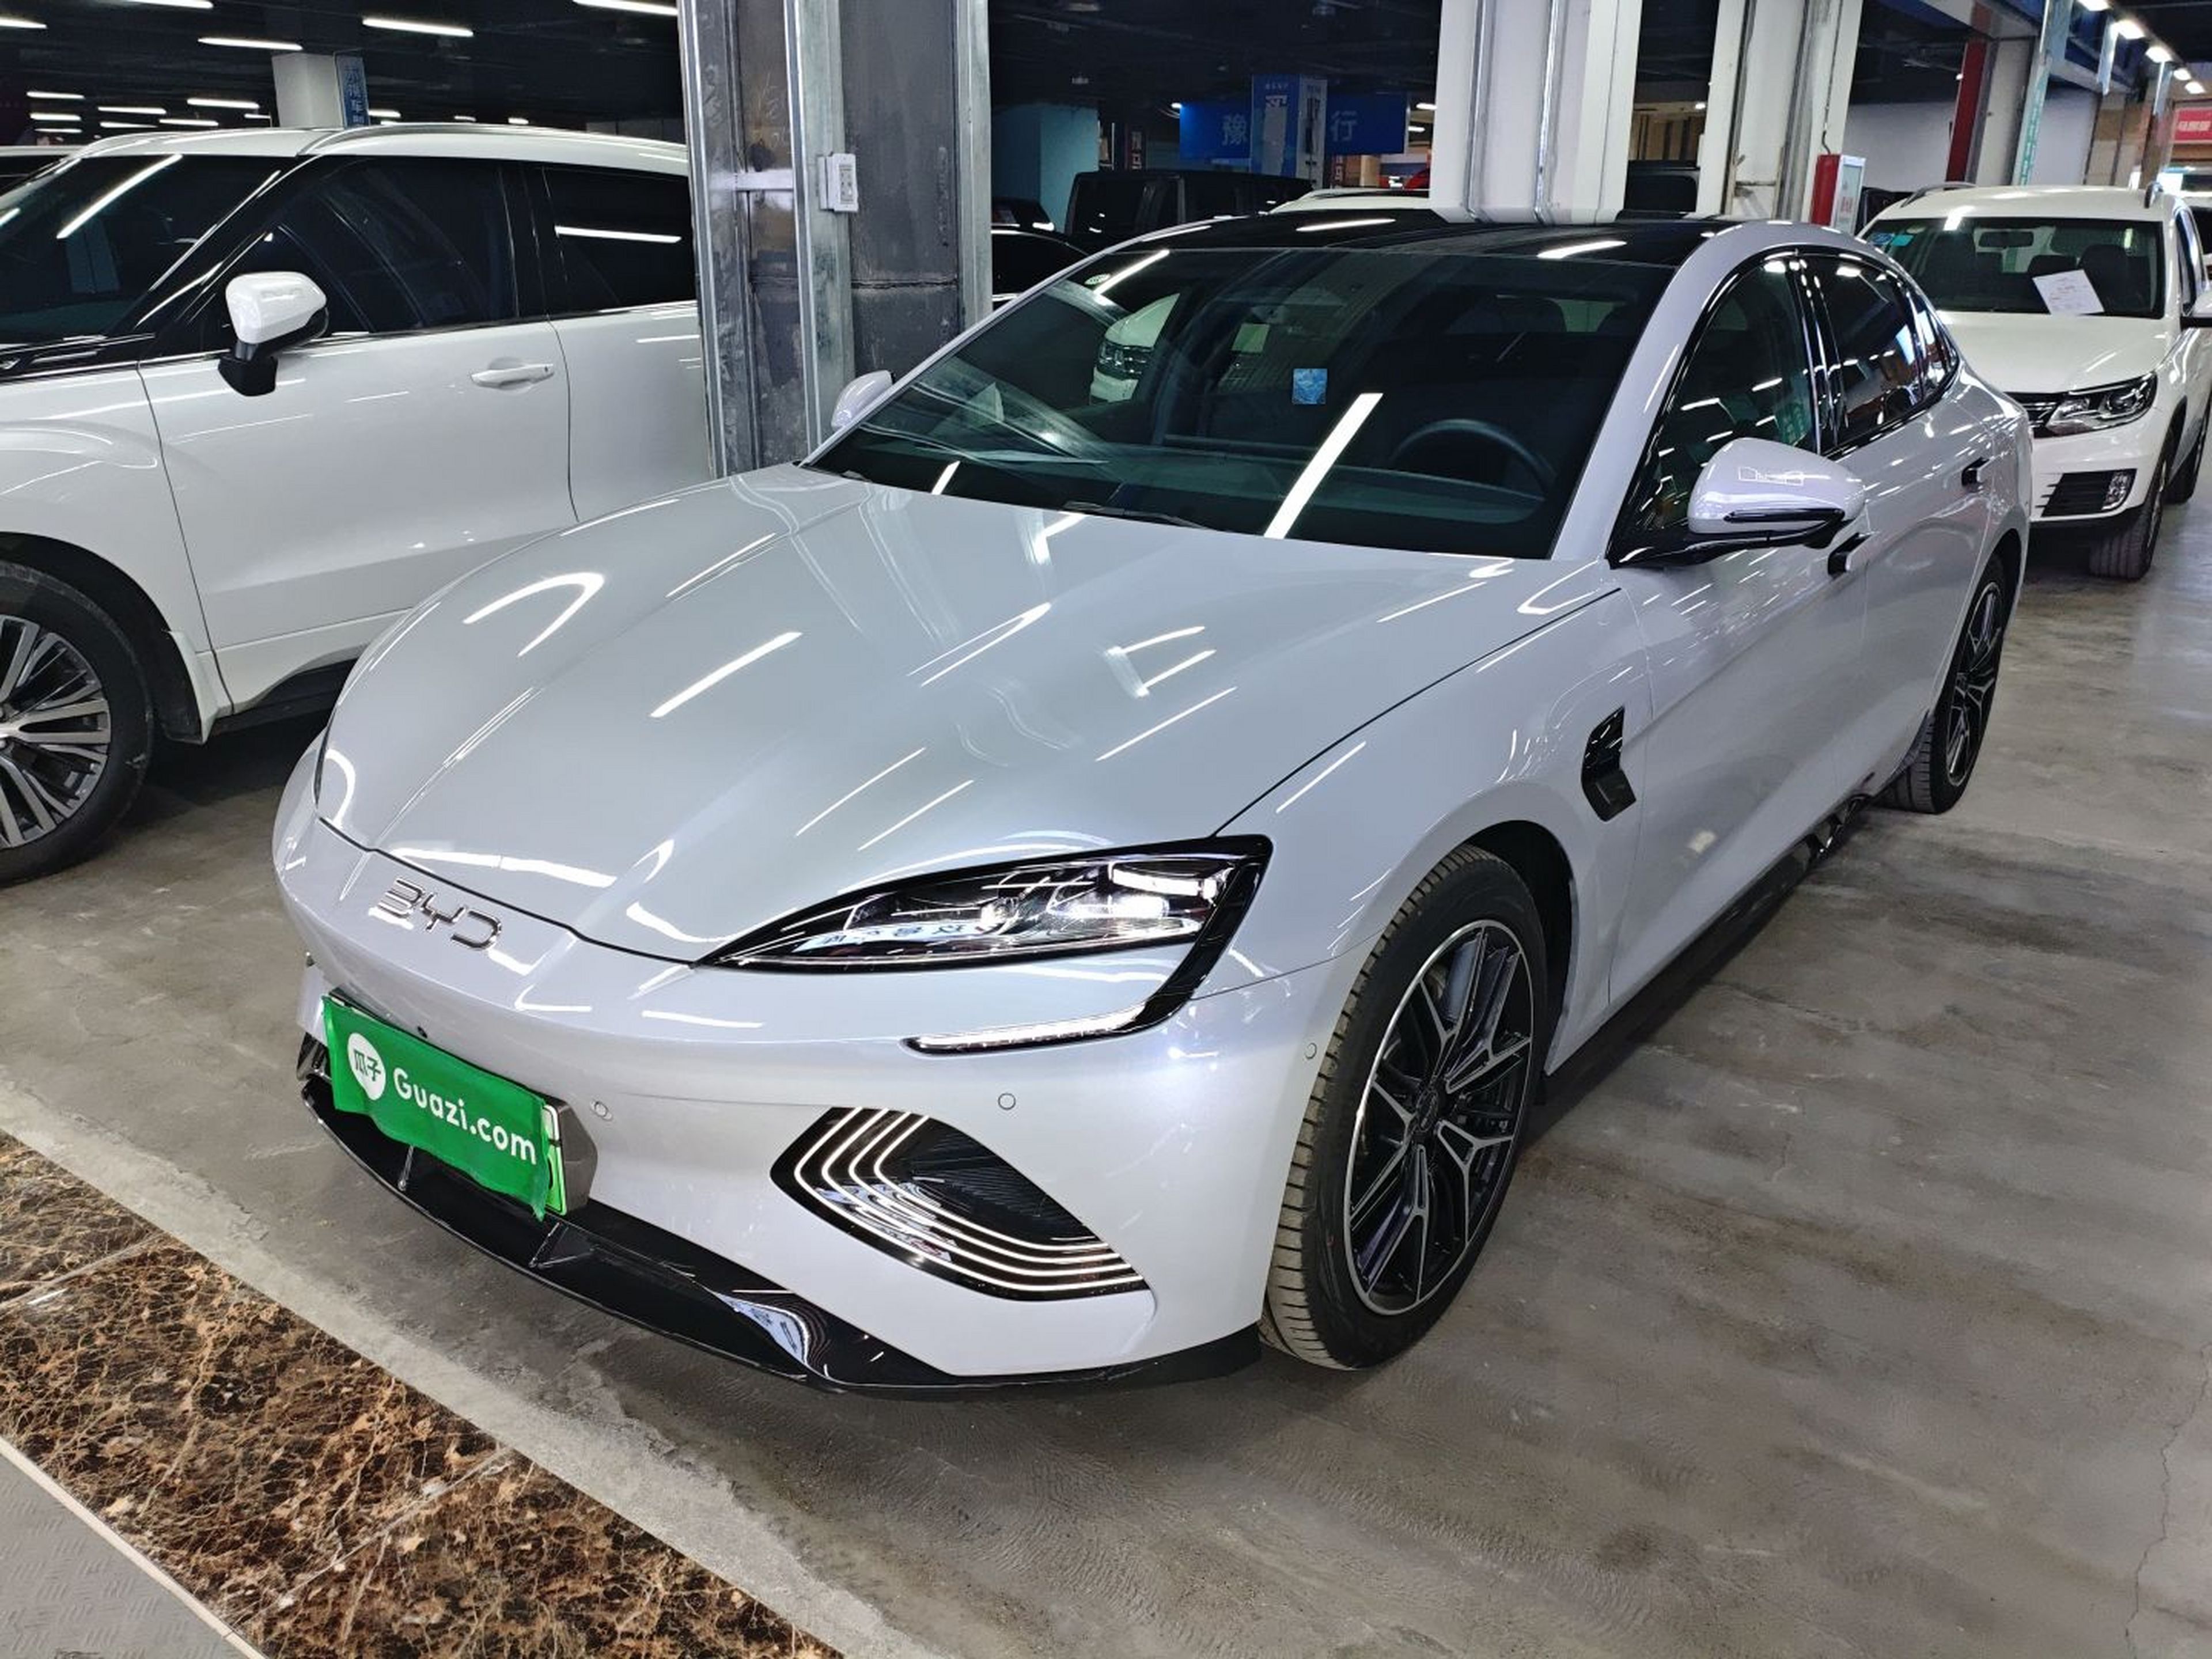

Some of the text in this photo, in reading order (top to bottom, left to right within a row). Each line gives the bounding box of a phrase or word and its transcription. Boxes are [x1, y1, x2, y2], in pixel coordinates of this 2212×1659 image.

[1331, 110, 1358, 142] 行
[378, 877, 502, 950] BYD
[353, 1050, 381, 1082] 瓜子
[393, 1067, 537, 1165] Guazi.com
